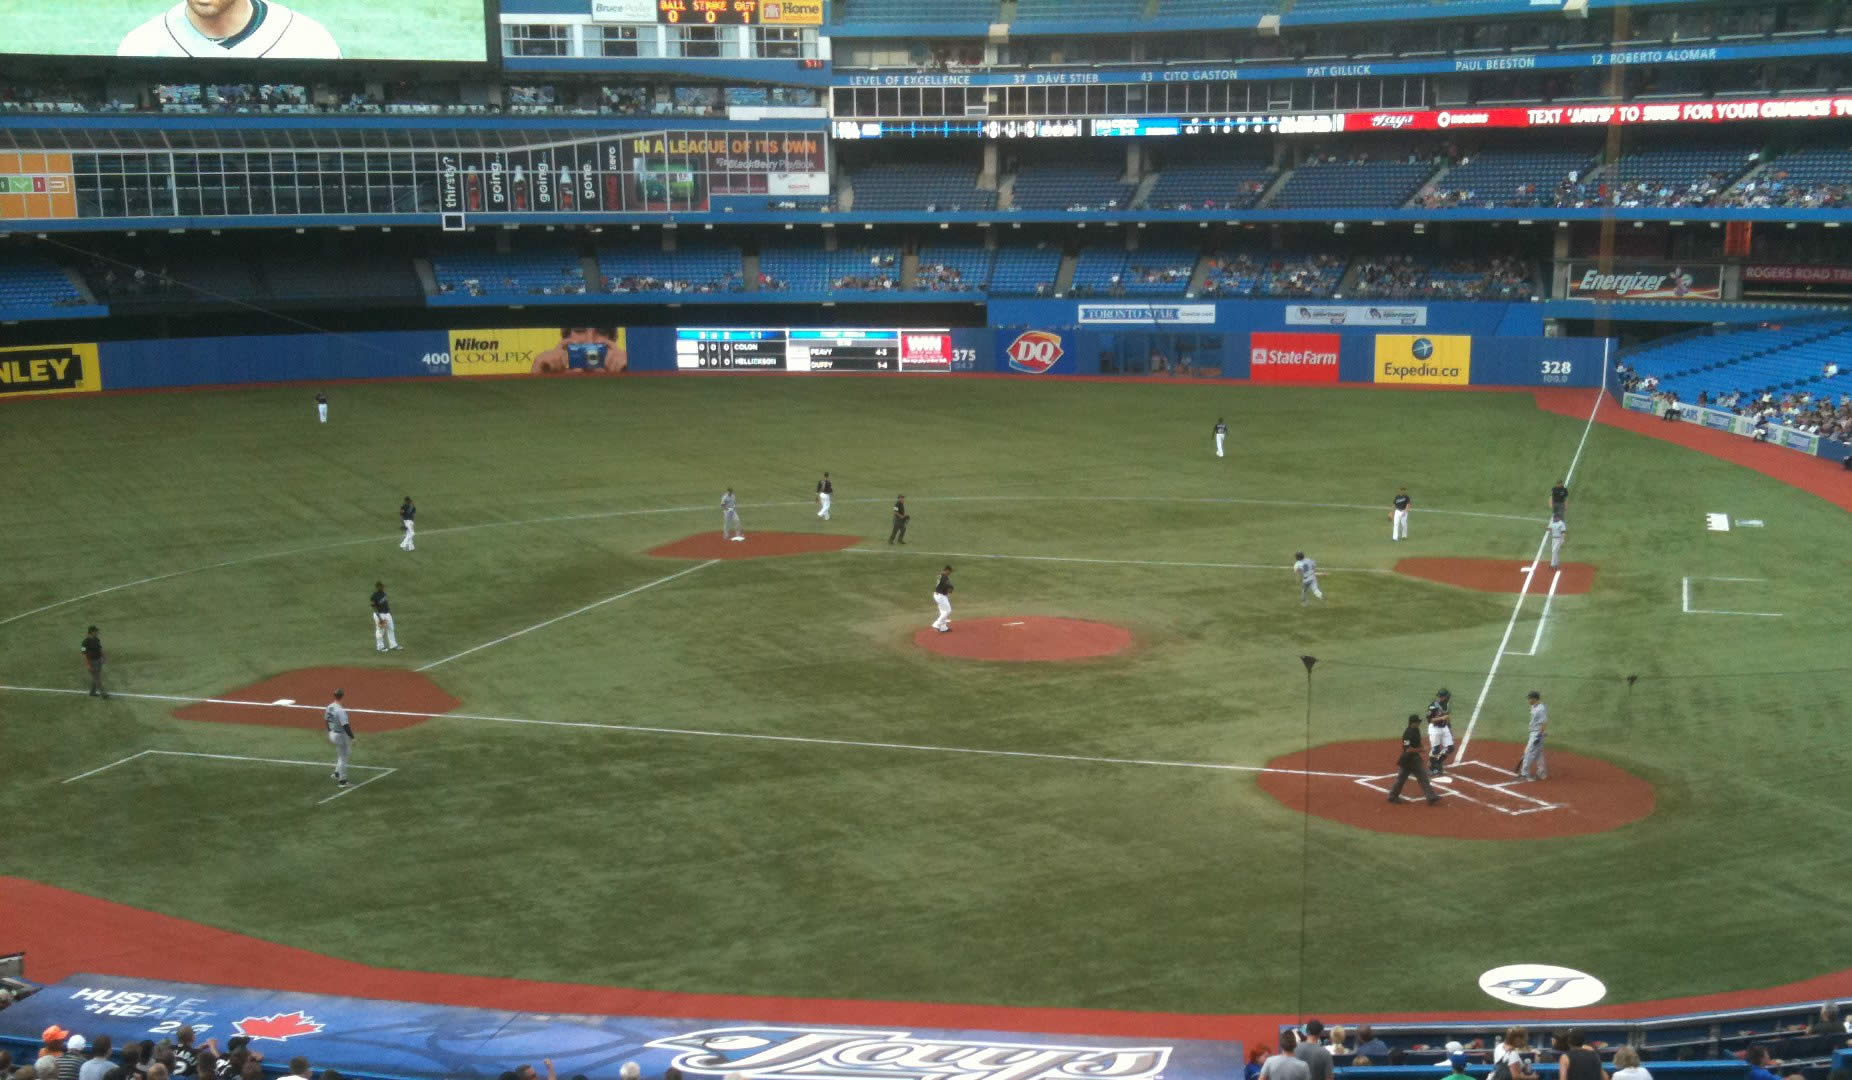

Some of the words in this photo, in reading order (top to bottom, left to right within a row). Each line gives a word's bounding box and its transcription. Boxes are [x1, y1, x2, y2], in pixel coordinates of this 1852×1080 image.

[782, 2, 819, 14] Home
[668, 9, 678, 23] 0
[706, 9, 716, 23] 0
[742, 11, 750, 23] 1
[1592, 54, 1602, 65] 12
[1610, 51, 1662, 64] ROBERTO
[1667, 48, 1717, 60] ALOMAR
[1307, 67, 1326, 77] PAT
[1330, 65, 1371, 75] GILLICK
[1455, 60, 1483, 71] PAUL
[1486, 58, 1535, 70] BEESTON
[850, 76, 882, 86] LEVEL
[885, 76, 899, 86] OF
[903, 75, 971, 85] EXCELLENCE
[1036, 74, 1067, 84] DAVE
[1070, 73, 1099, 83] STIEB
[1163, 71, 1189, 81] CITO
[1193, 69, 1238, 80] GASTON
[1527, 109, 1562, 124] TEXT
[1618, 106, 1640, 121] TO
[1683, 104, 1714, 119] FOR
[1715, 102, 1758, 118] YOUR
[634, 140, 650, 154] IN
[654, 140, 665, 154] A
[669, 140, 728, 154] LEAGUE
[732, 140, 750, 153] OF
[755, 140, 779, 153] ITS
[782, 140, 817, 153] OWN
[442, 156, 457, 208] thirsty?
[1746, 266, 1793, 279] ROGERS
[1795, 267, 1830, 280] ROAD
[1579, 268, 1667, 295] Energizer
[1087, 308, 1142, 320] TORONTO
[1144, 308, 1174, 320] STAR
[454, 338, 499, 351] Nikon
[734, 343, 758, 351] COLON
[454, 350, 533, 364] COOLPIX
[952, 349, 976, 362] 375
[1016, 340, 1056, 363] DQ
[422, 352, 450, 365] 400
[1384, 362, 1459, 379] Expedia.ca
[1541, 361, 1571, 374] 328
[70, 988, 207, 1010] HUSTLE
